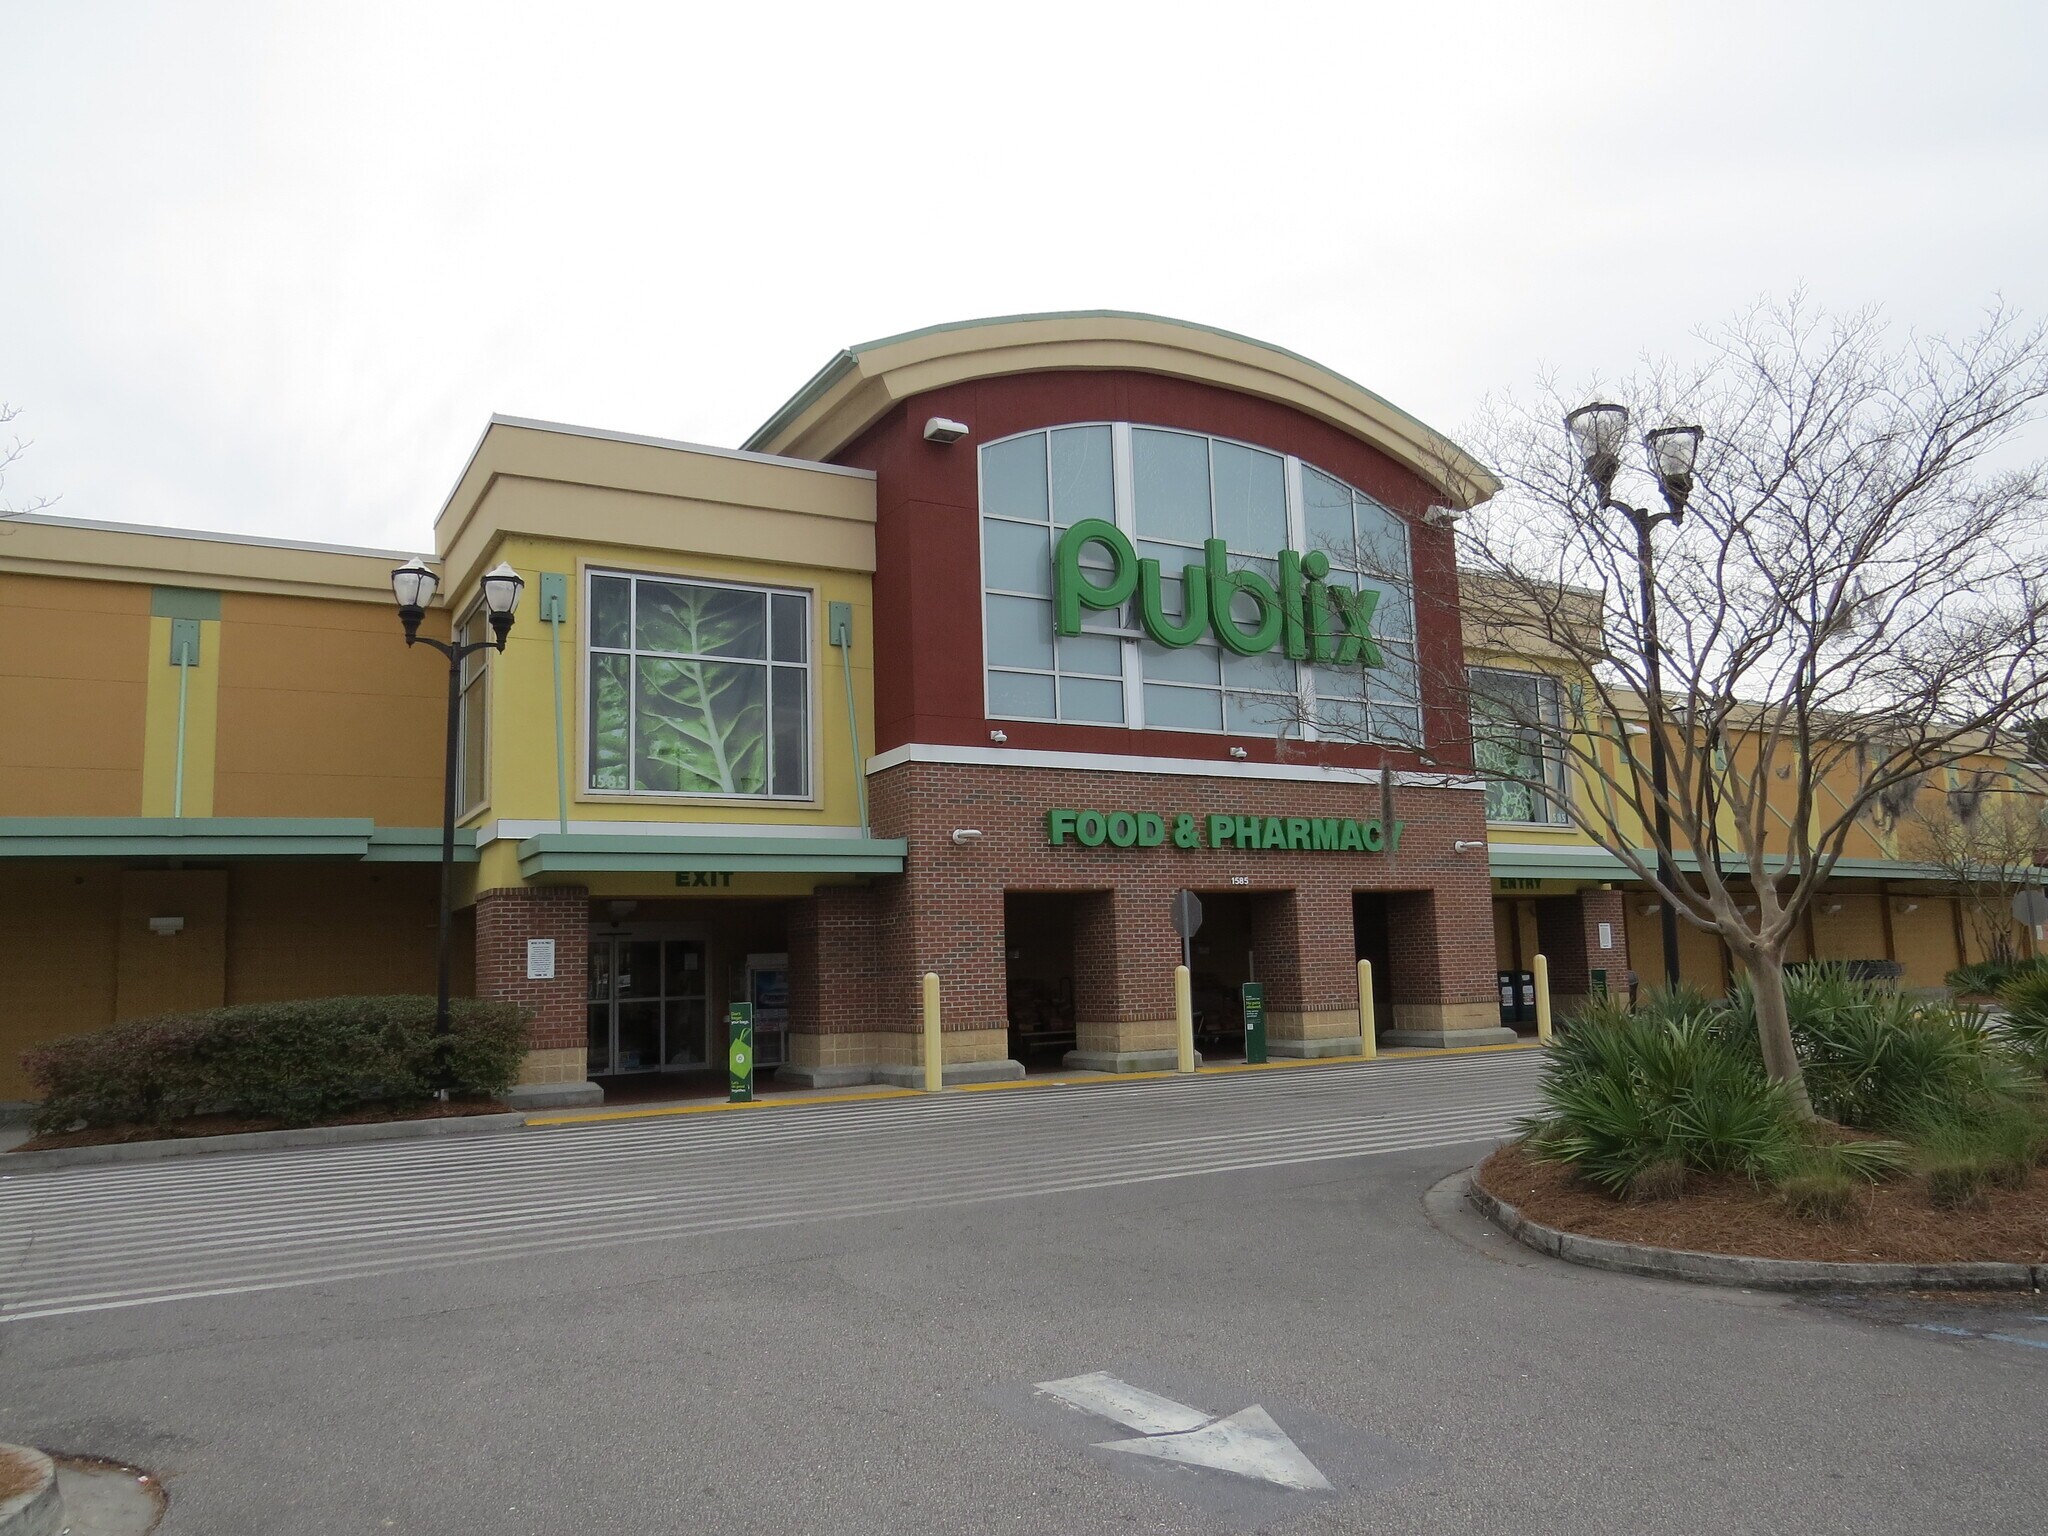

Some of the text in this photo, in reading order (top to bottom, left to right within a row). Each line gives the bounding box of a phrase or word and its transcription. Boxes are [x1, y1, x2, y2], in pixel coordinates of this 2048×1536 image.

[1054, 518, 1384, 669] Publix
[591, 774, 627, 789] 1585
[1047, 809, 1165, 847] FOOD
[1172, 811, 1200, 849] &
[676, 871, 734, 887] EXIT
[1231, 876, 1249, 885] 1585
[1500, 877, 1541, 889] ENTRY
